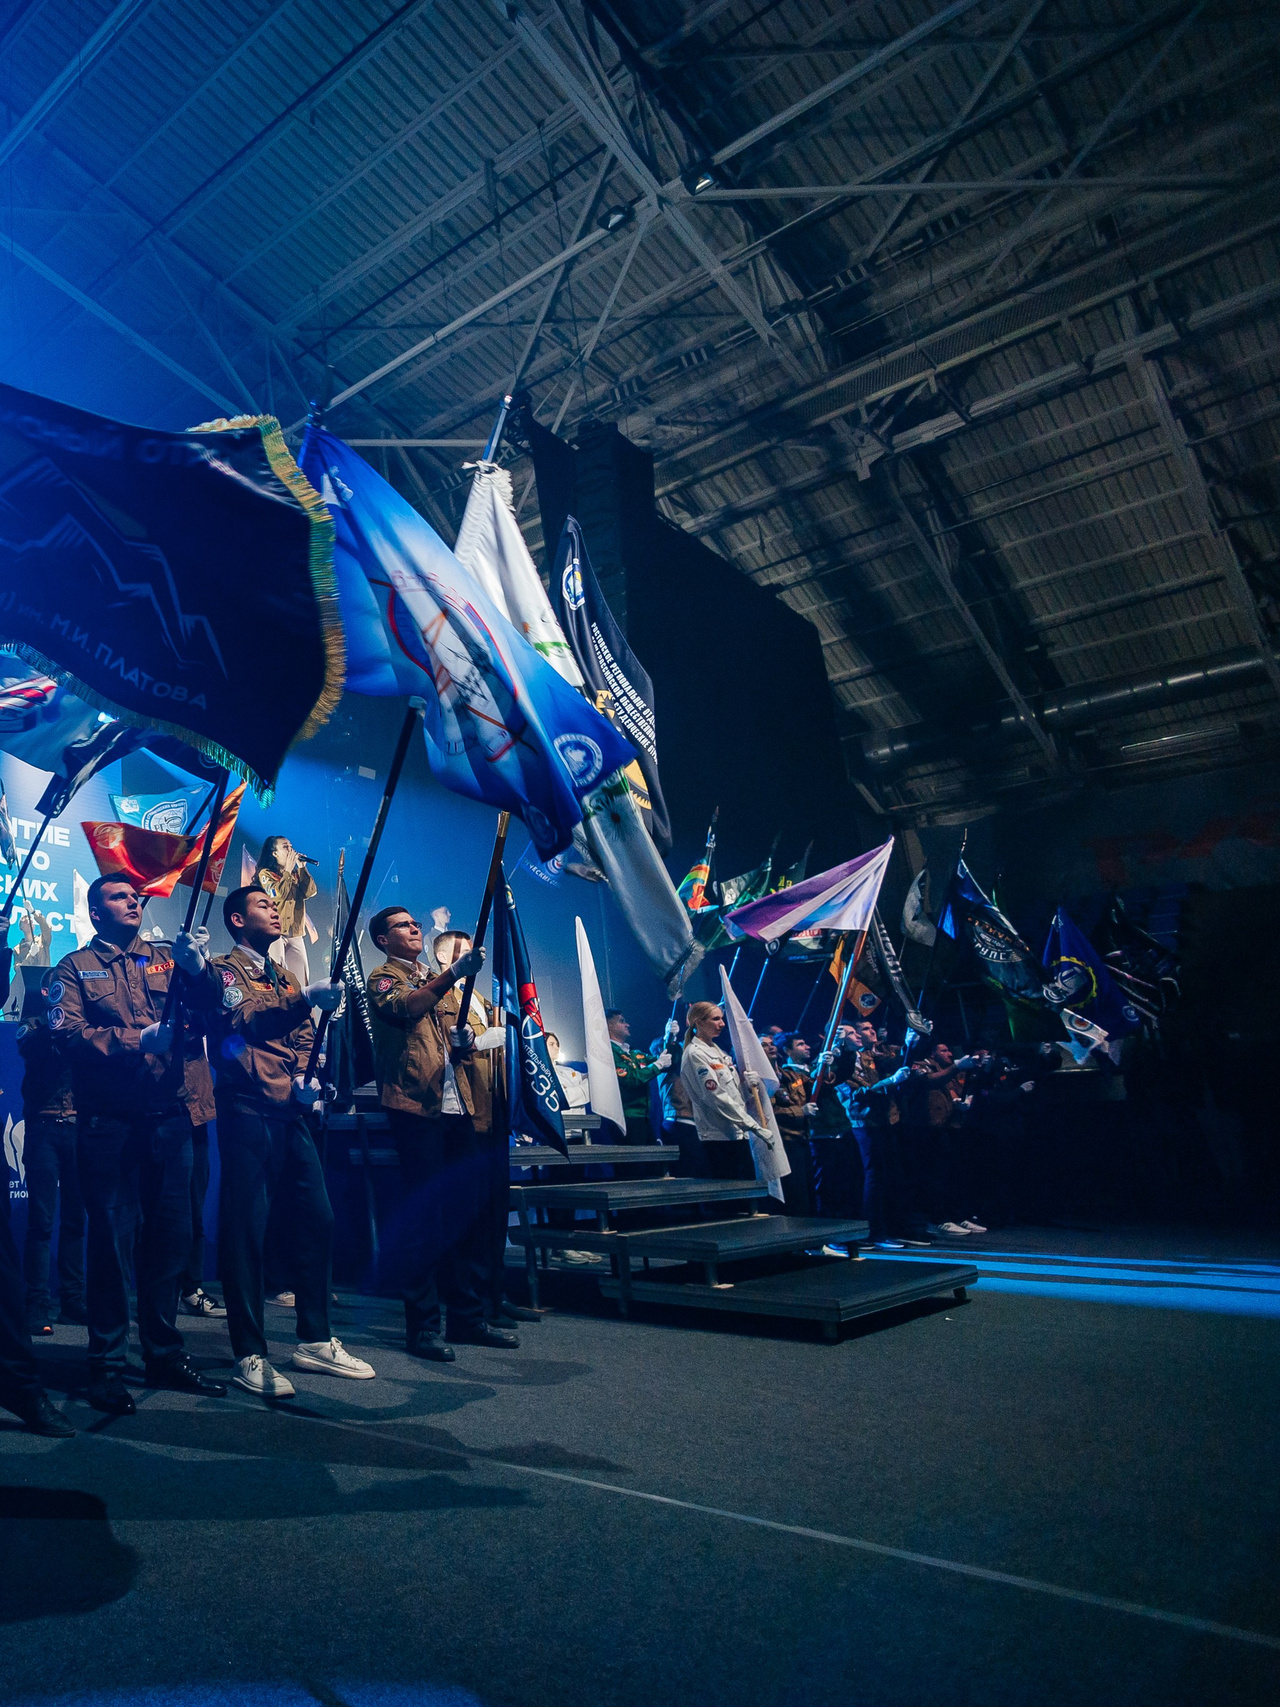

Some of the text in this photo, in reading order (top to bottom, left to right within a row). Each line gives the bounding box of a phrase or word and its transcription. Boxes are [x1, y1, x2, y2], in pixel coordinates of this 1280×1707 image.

[95, 641, 207, 711] ПЛАТОВА
[609, 661, 647, 711] РЕГИОНАЛЬНОЕ
[9, 1180, 20, 1189] ет
